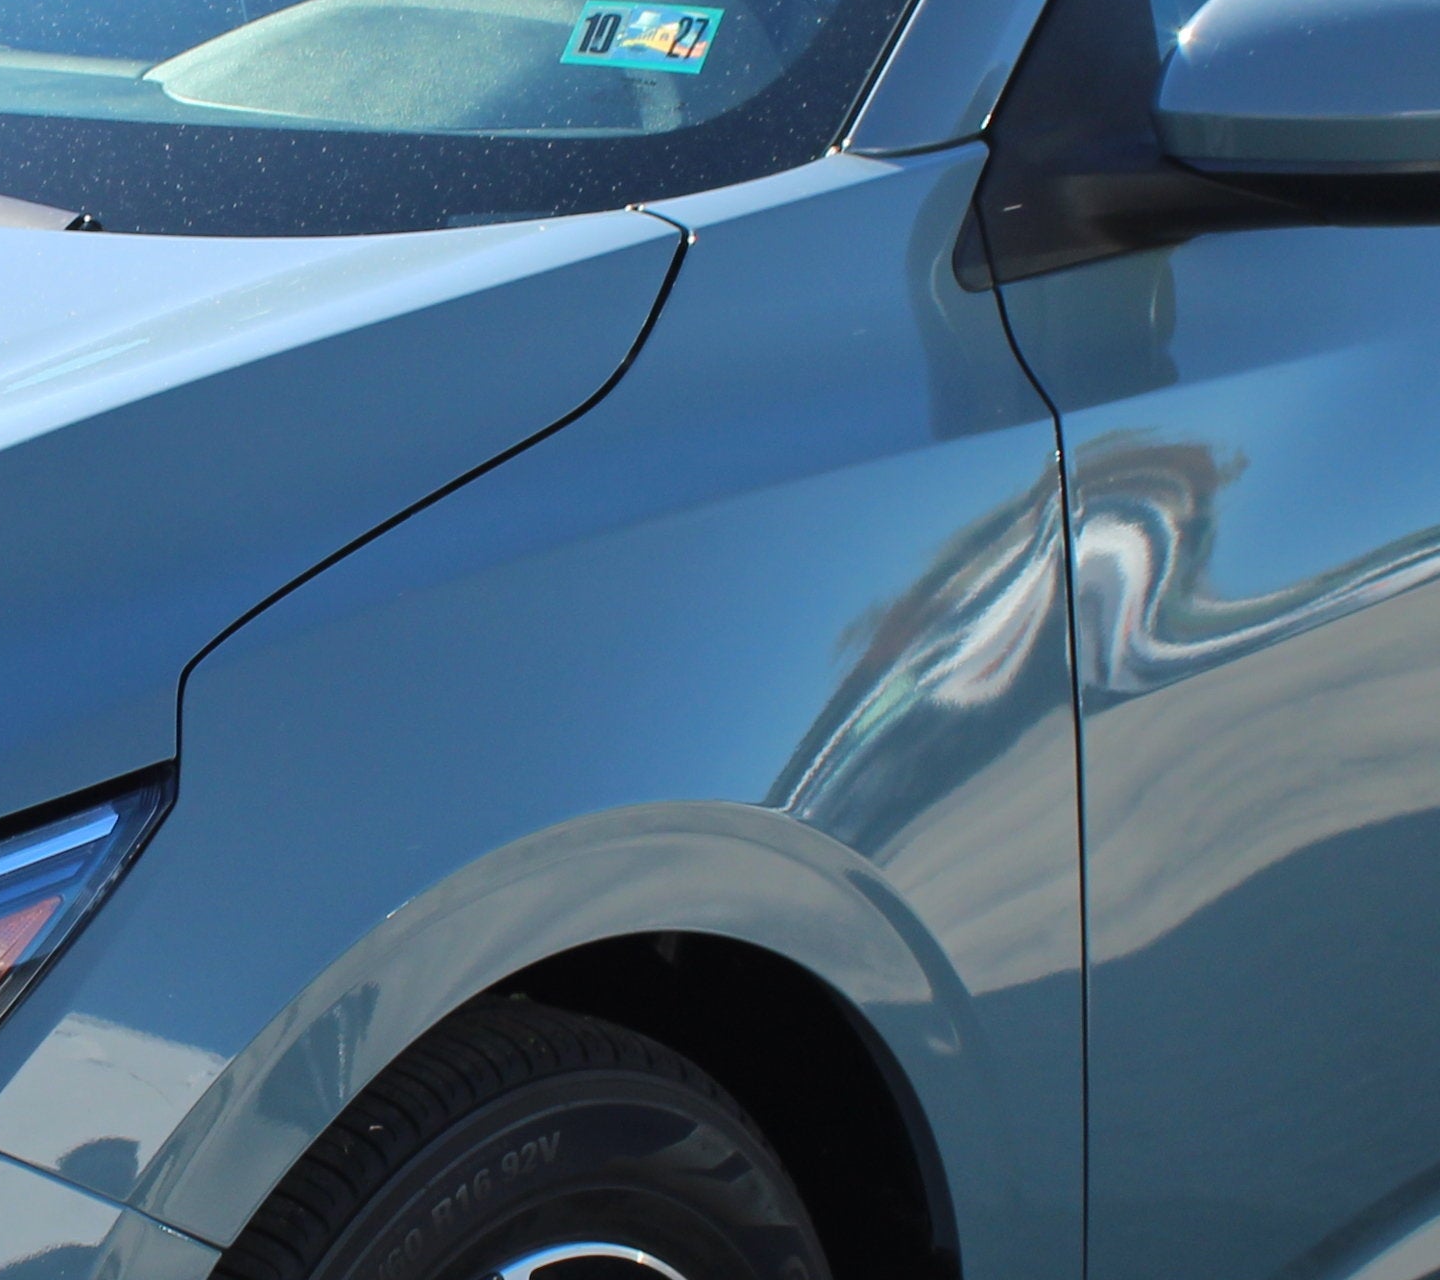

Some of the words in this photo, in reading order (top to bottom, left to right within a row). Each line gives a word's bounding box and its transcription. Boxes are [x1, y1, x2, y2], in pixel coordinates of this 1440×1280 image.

[577, 11, 622, 55] 10
[666, 16, 710, 61] 27
[431, 1168, 493, 1234] R16
[501, 1130, 561, 1183] 92V
